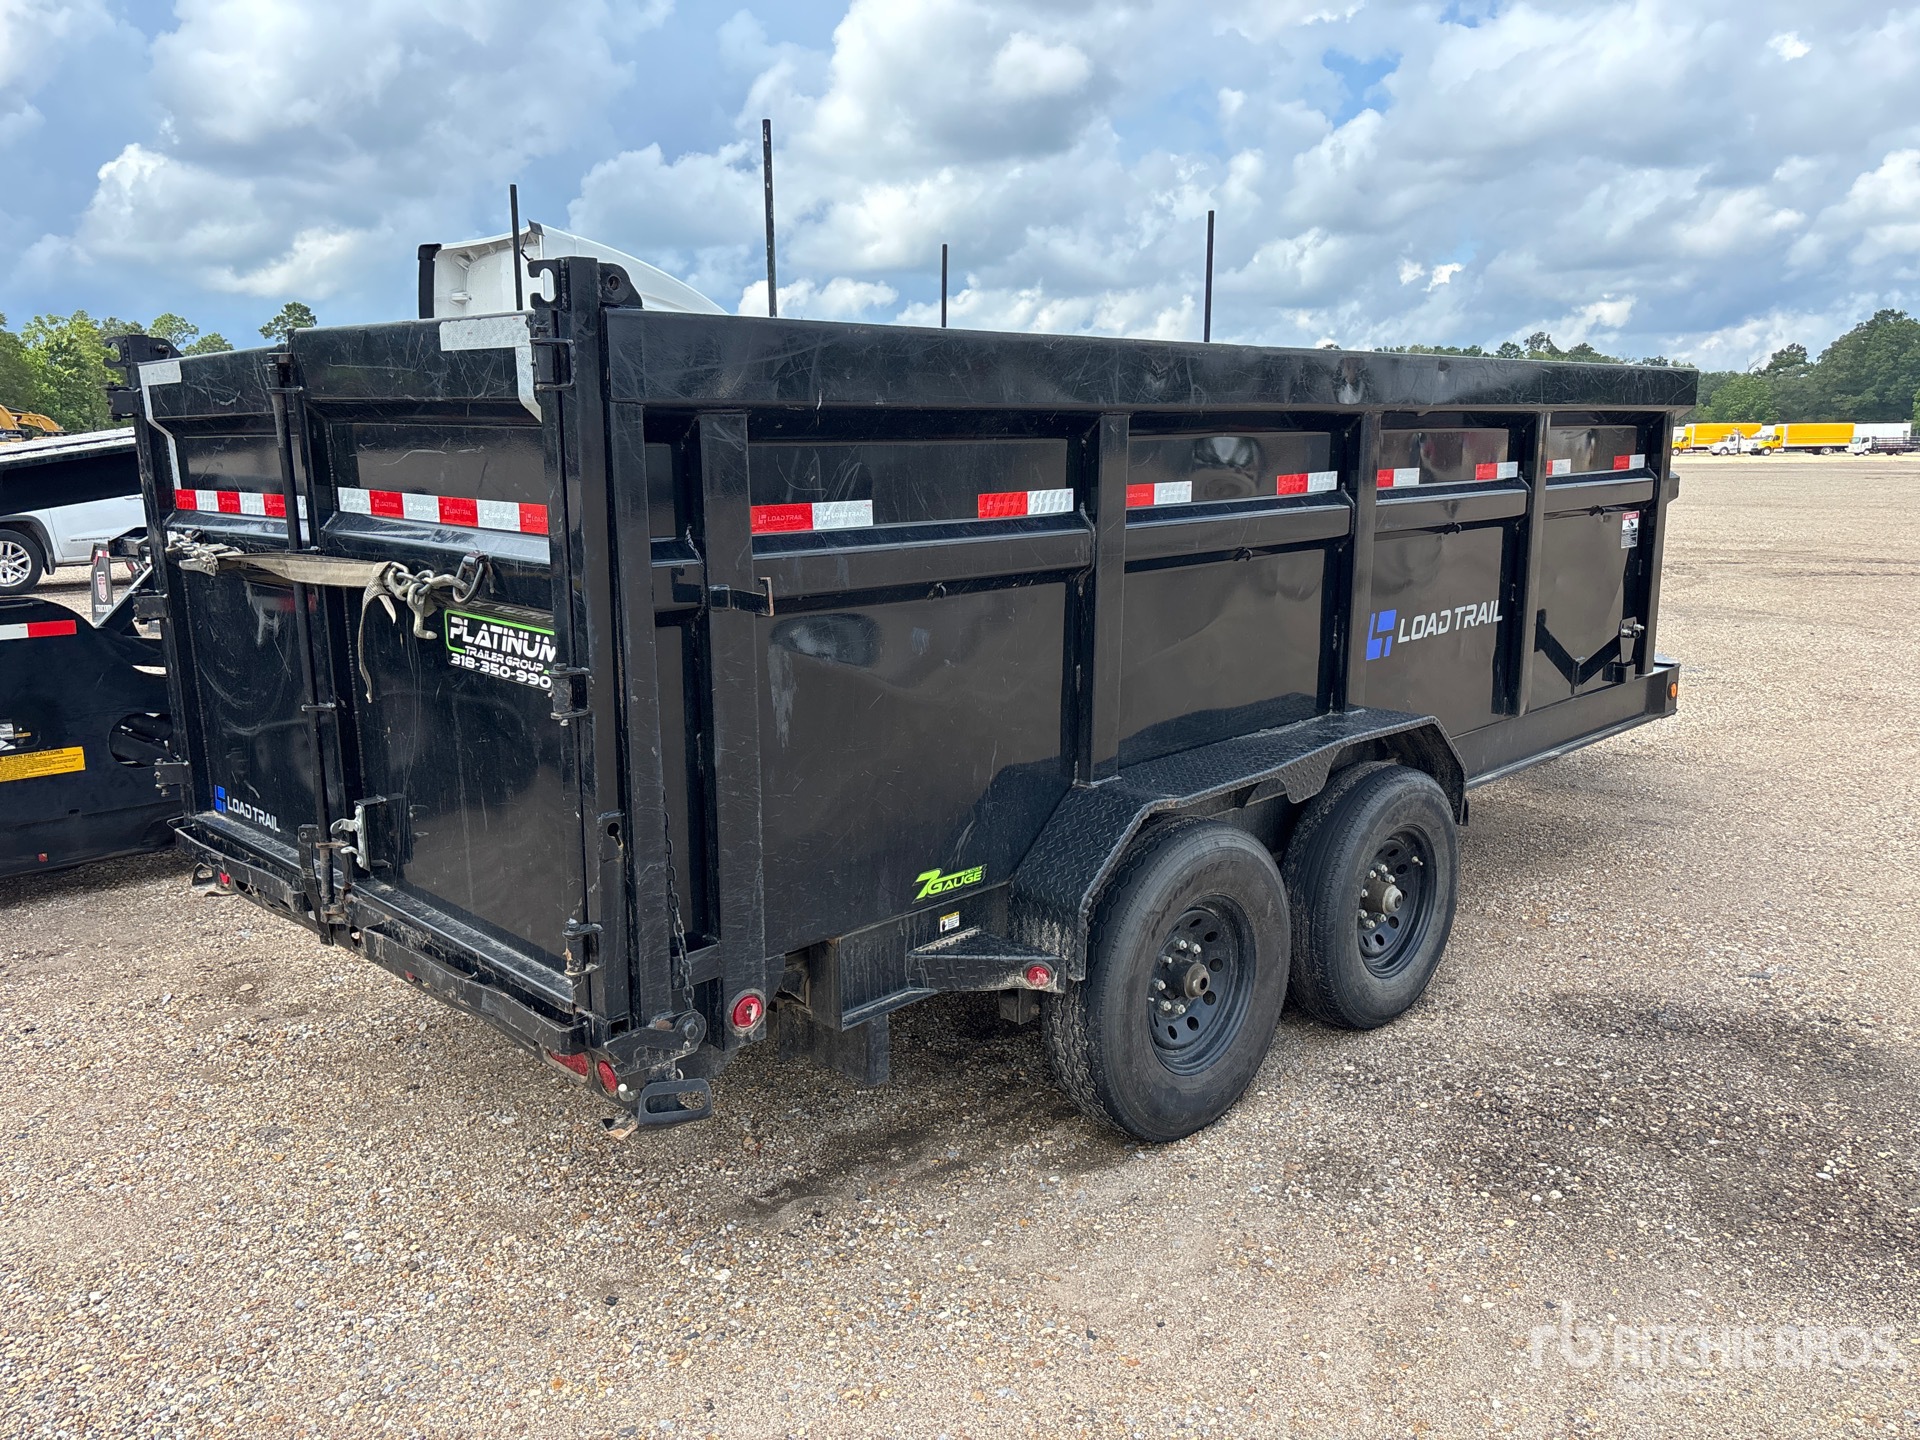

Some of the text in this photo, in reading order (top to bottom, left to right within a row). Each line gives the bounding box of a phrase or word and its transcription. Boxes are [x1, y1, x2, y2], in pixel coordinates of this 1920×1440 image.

[1397, 599, 1503, 643] LOAD TRAIL
[464, 645, 544, 673] TRAILER GROUP
[227, 796, 281, 832] LOAD TRAIL
